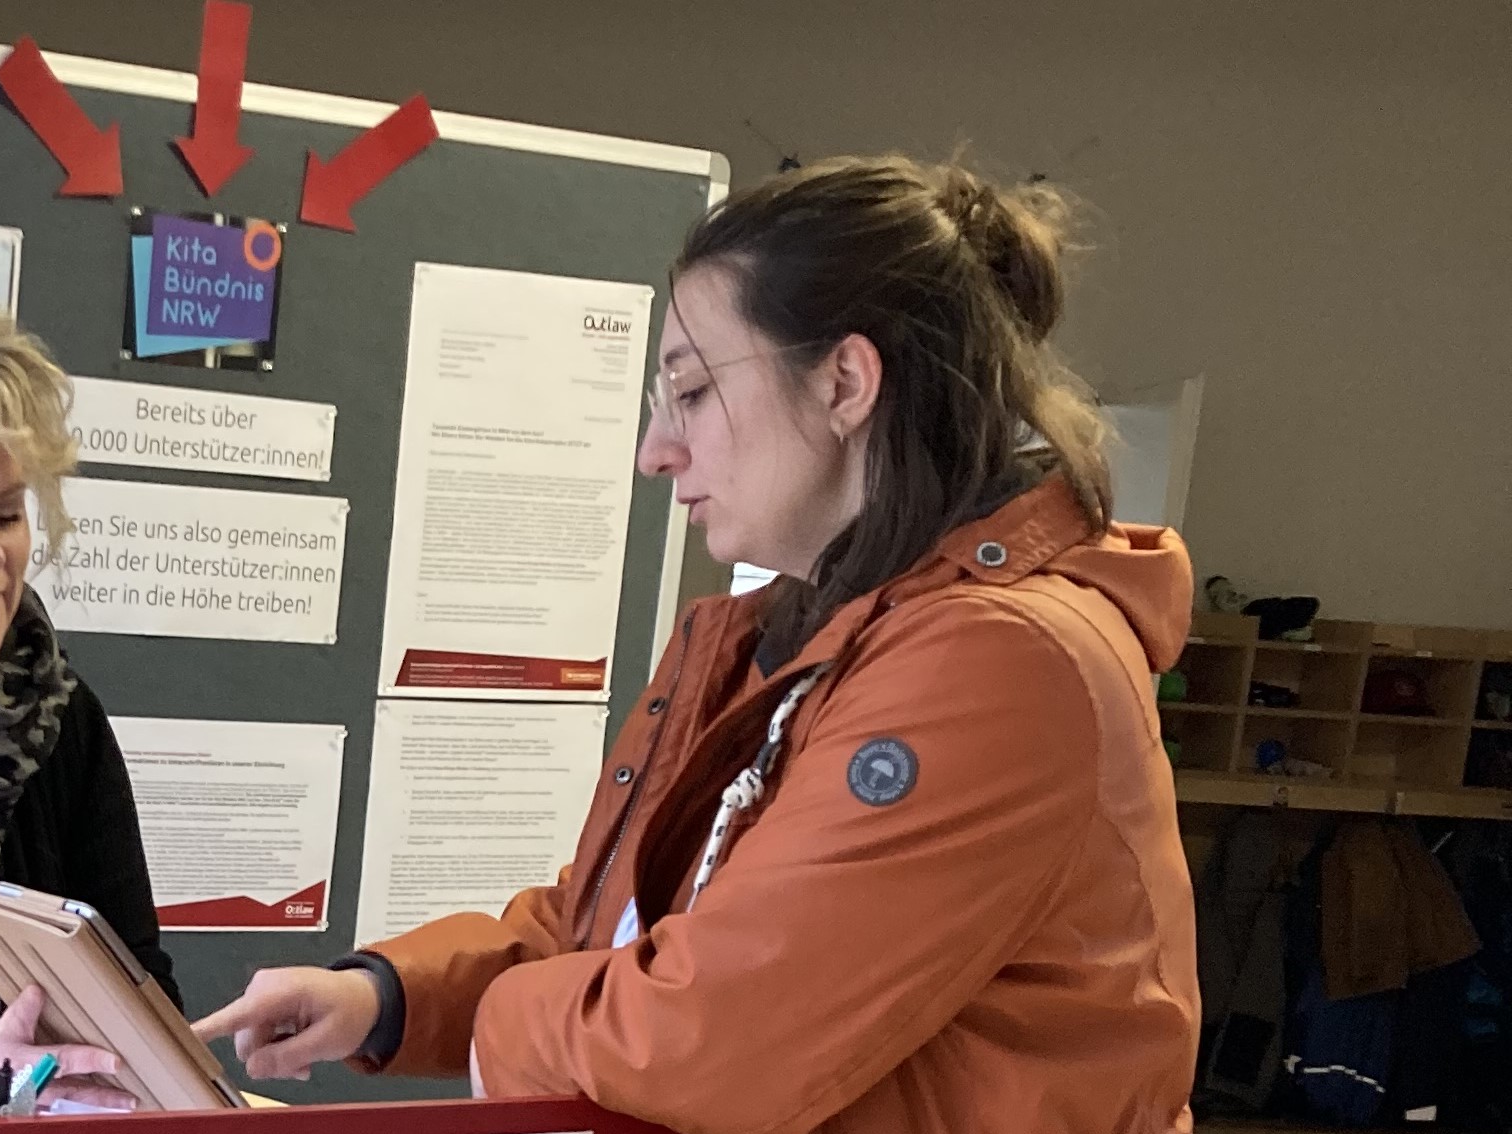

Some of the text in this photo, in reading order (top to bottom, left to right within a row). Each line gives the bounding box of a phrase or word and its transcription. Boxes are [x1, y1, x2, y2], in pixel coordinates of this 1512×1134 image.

[166, 235, 217, 266] Kita
[164, 265, 265, 302] Bündnis
[162, 298, 221, 329] NRW
[136, 398, 257, 430] Bereits über
[134, 432, 326, 469] Unterstützer:innen!
[109, 515, 138, 538] Sie
[144, 521, 178, 541] uns
[183, 520, 222, 543] also
[227, 527, 337, 550] gemeinsam
[68, 546, 110, 569] Zahl
[116, 548, 150, 571] der
[155, 552, 337, 583] Unterstützer:innen
[52, 580, 312, 615] weiter in die Höhe treiben!
